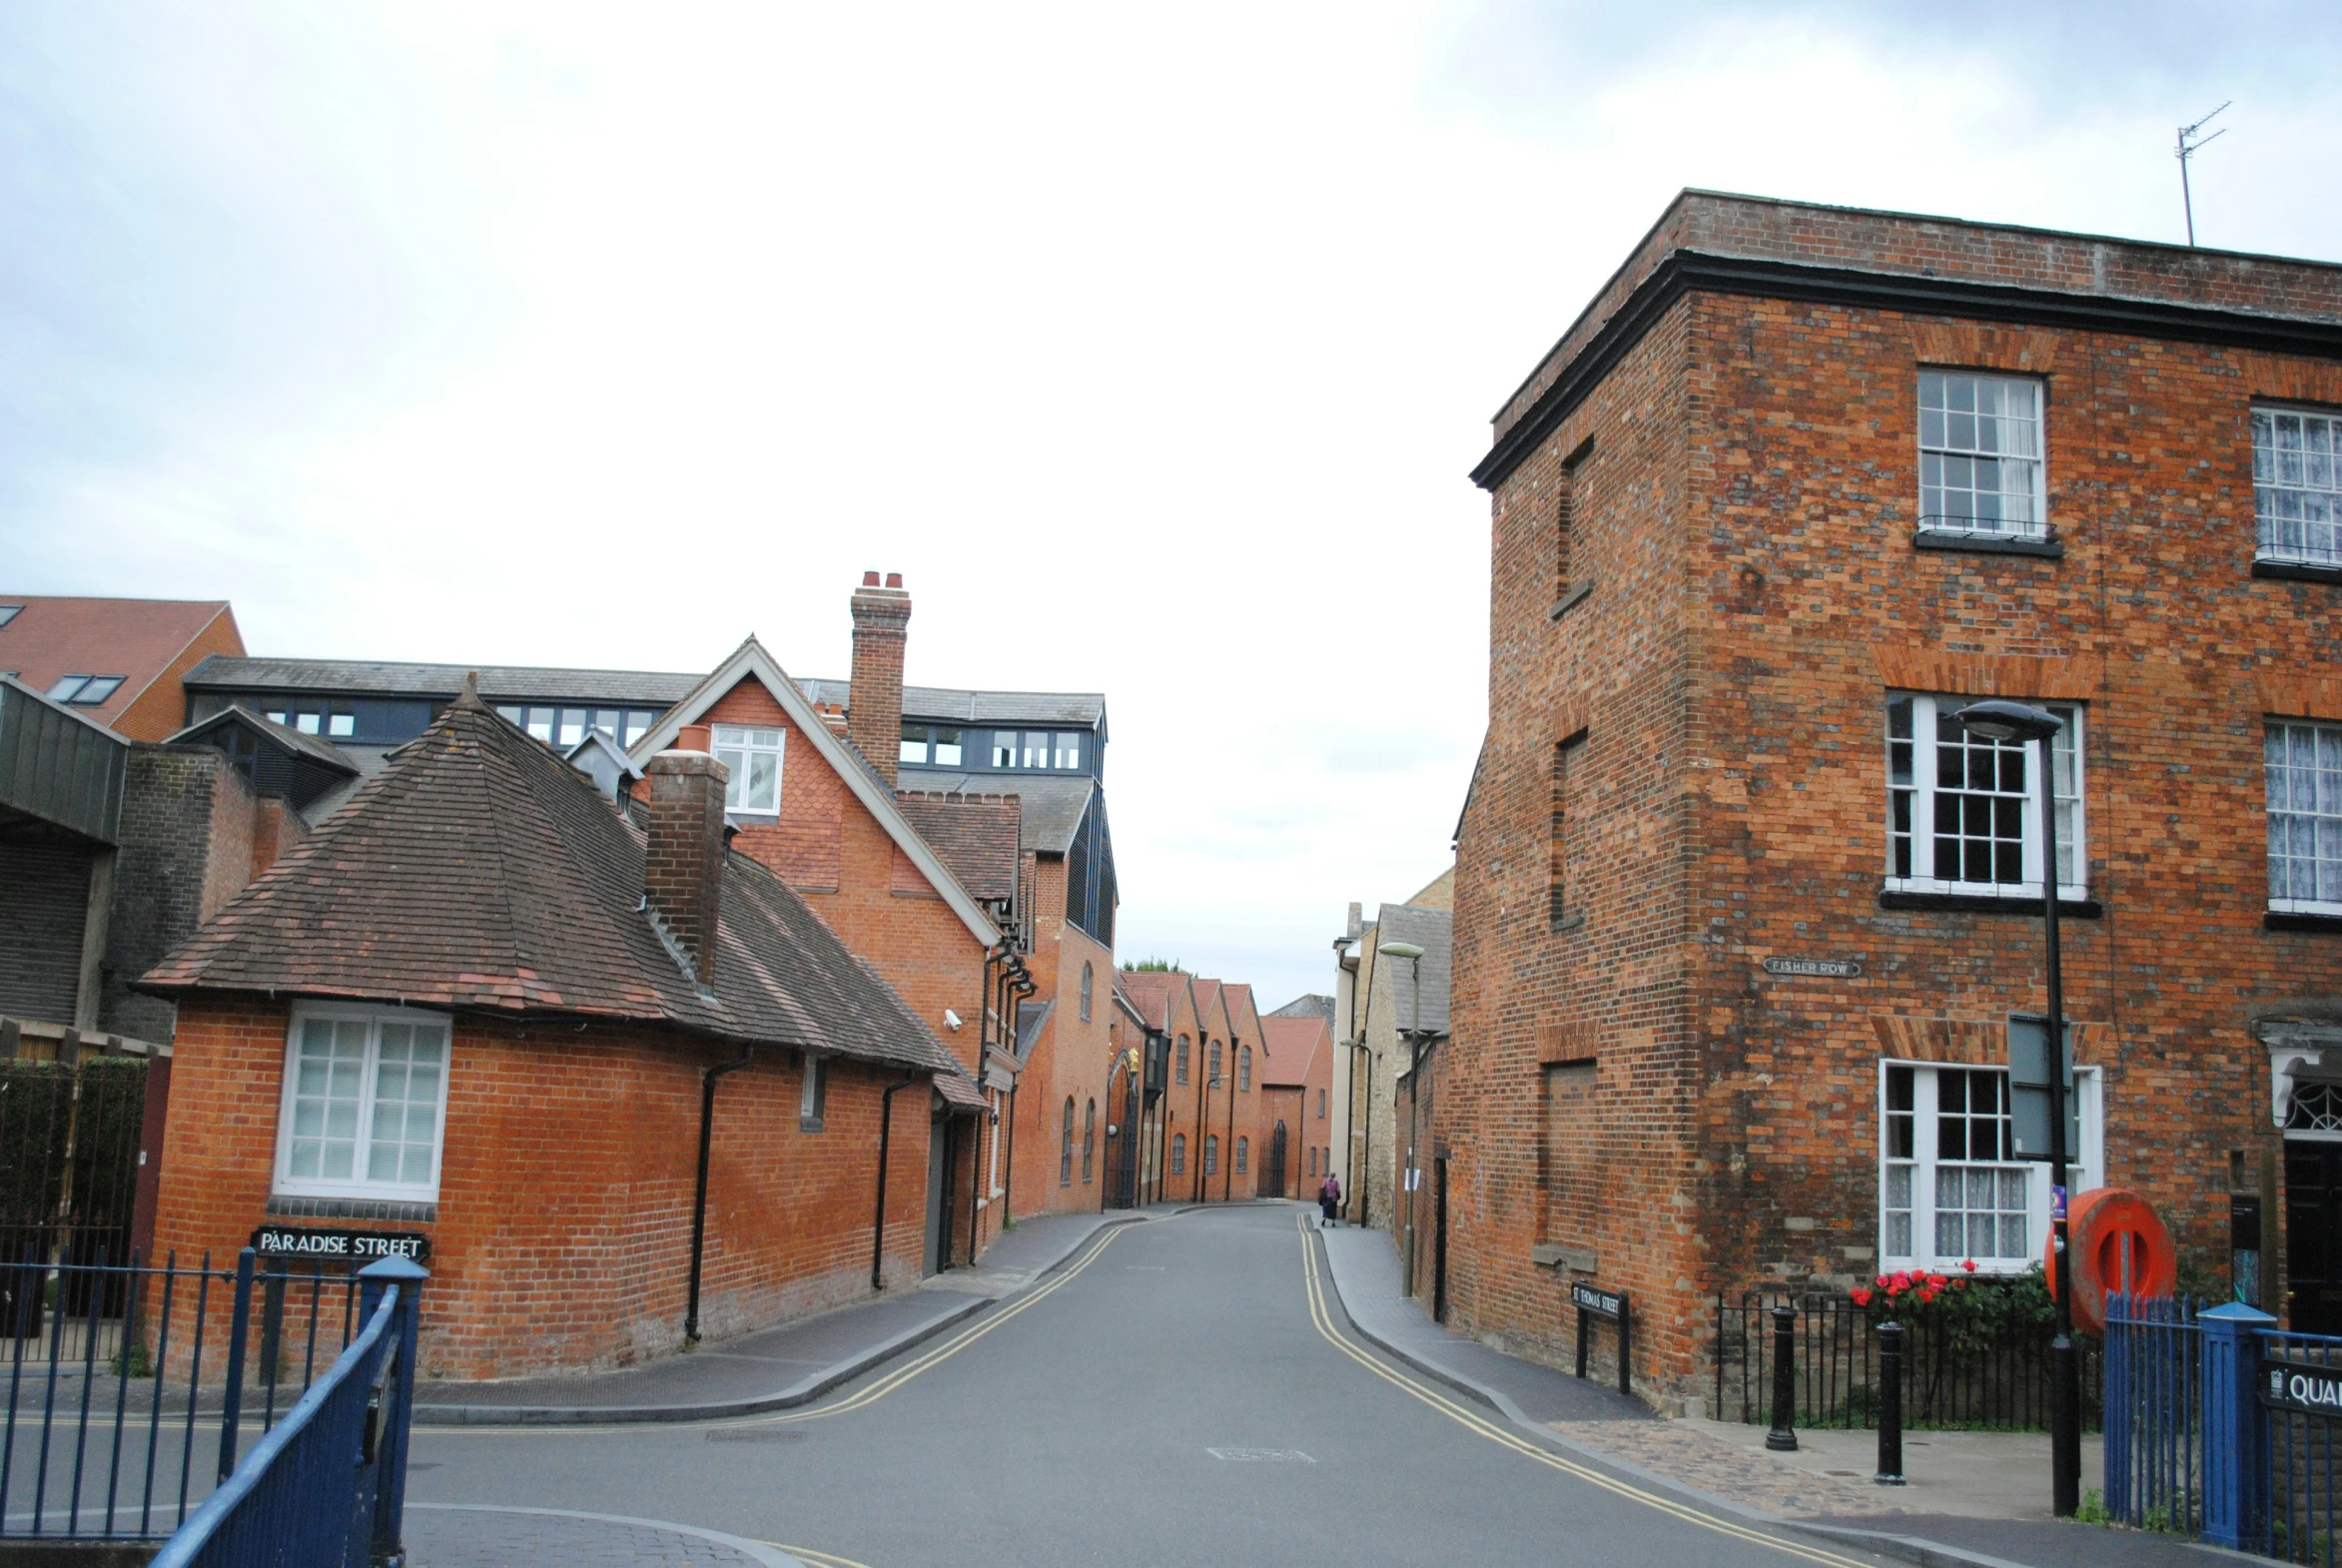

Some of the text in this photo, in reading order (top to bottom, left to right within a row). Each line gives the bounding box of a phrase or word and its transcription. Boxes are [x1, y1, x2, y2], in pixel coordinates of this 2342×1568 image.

[1773, 961, 1848, 975] FISHER ROW
[262, 1231, 421, 1257] PARADISE STREET
[1602, 1295, 1619, 1314] STREET
